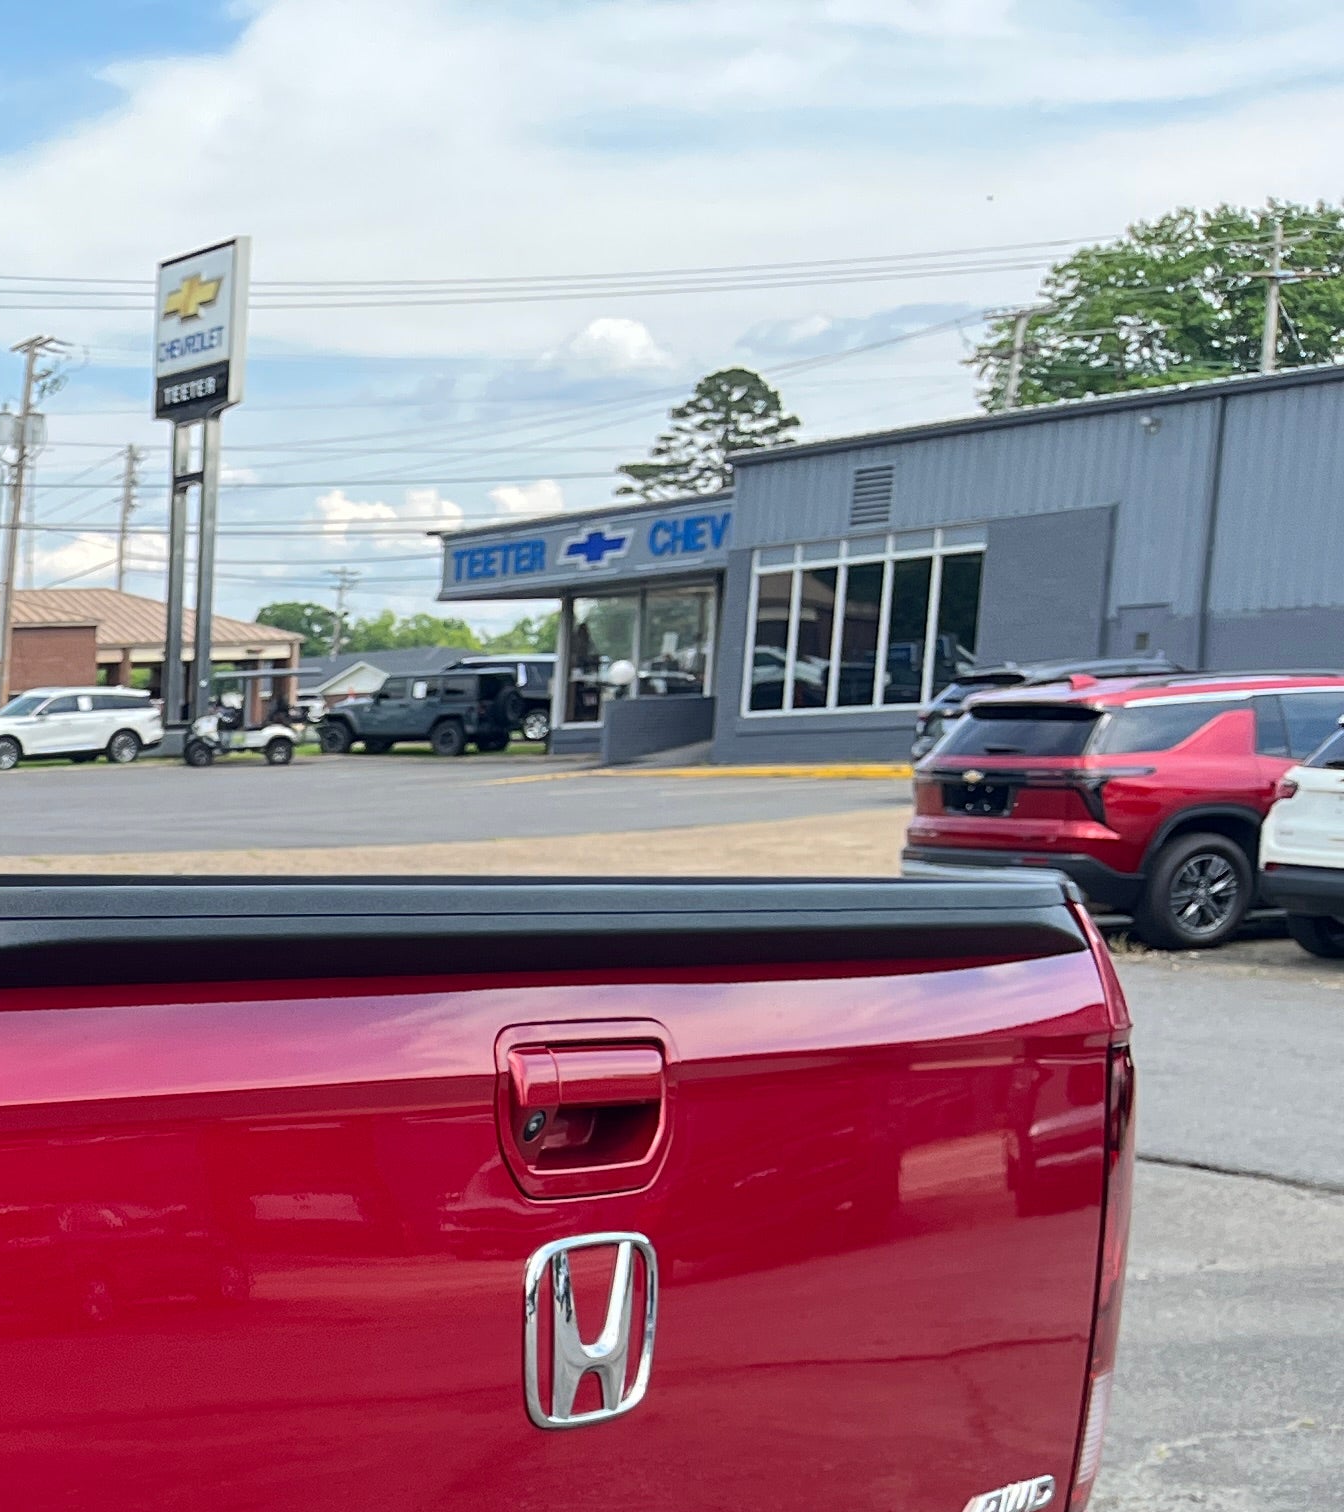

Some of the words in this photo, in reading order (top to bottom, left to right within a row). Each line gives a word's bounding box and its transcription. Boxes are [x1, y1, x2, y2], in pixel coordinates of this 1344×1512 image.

[158, 326, 224, 362] CHEVROLET
[164, 376, 216, 404] TEETER
[452, 540, 546, 583] TEETER
[648, 512, 731, 556] CHEV
